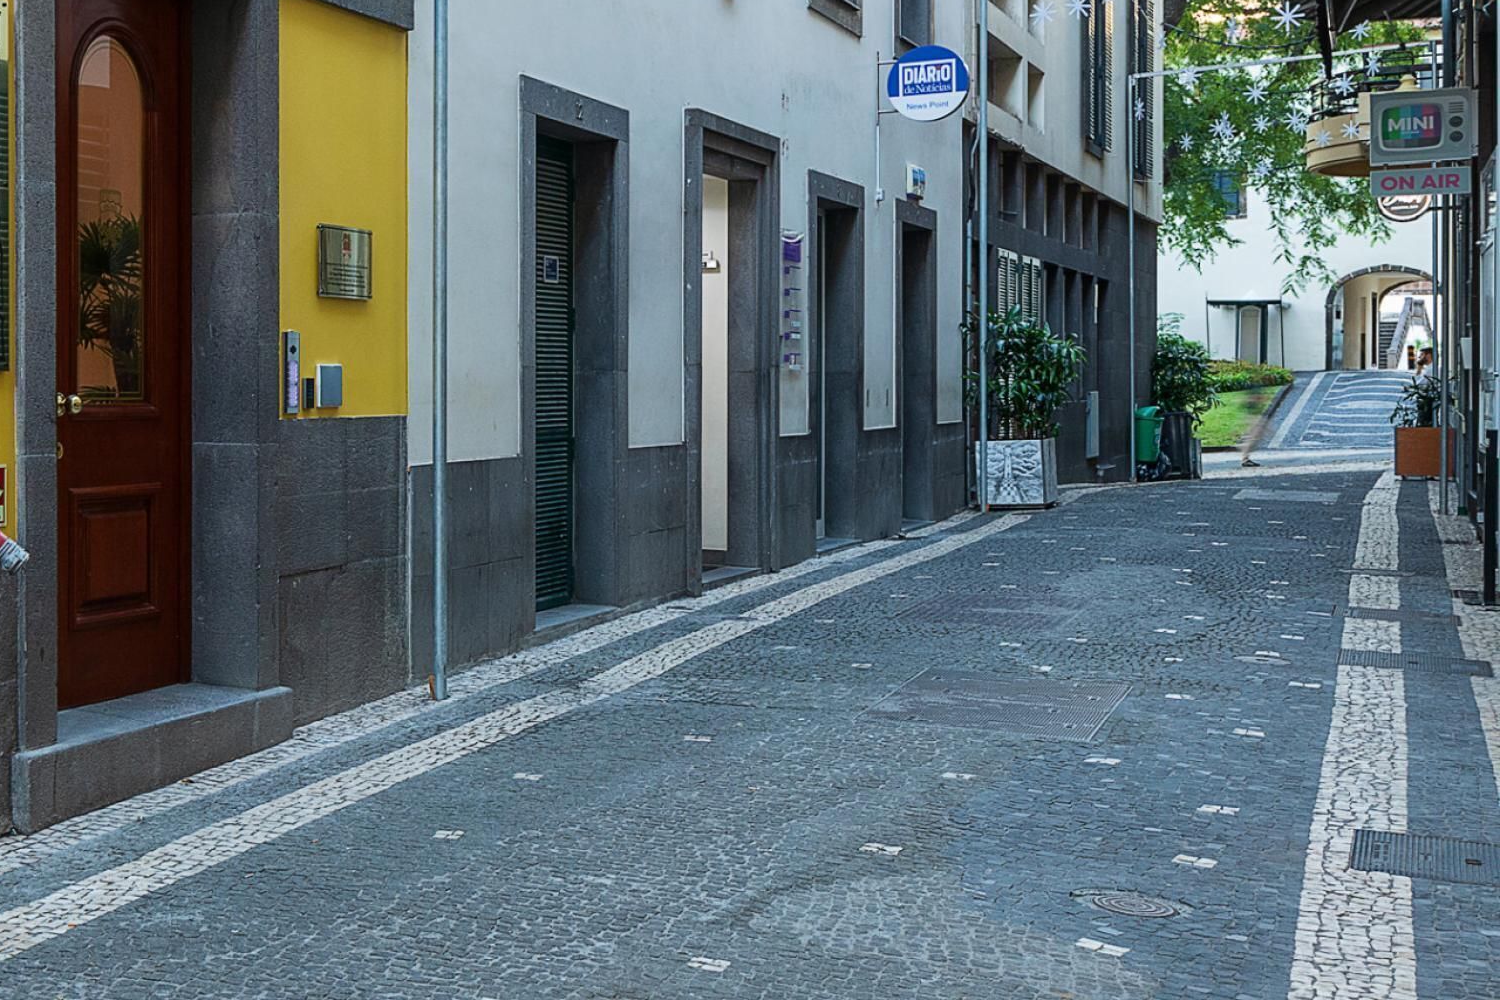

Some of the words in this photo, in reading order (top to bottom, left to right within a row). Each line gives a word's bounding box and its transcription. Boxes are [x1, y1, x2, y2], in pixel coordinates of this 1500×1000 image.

[904, 85, 915, 94] de
[915, 83, 951, 93] Notícias
[907, 103, 927, 111] News
[929, 101, 949, 109] Point
[1387, 116, 1434, 132] MINI
[1380, 176, 1415, 191] ON
[1421, 174, 1460, 189] AIR
